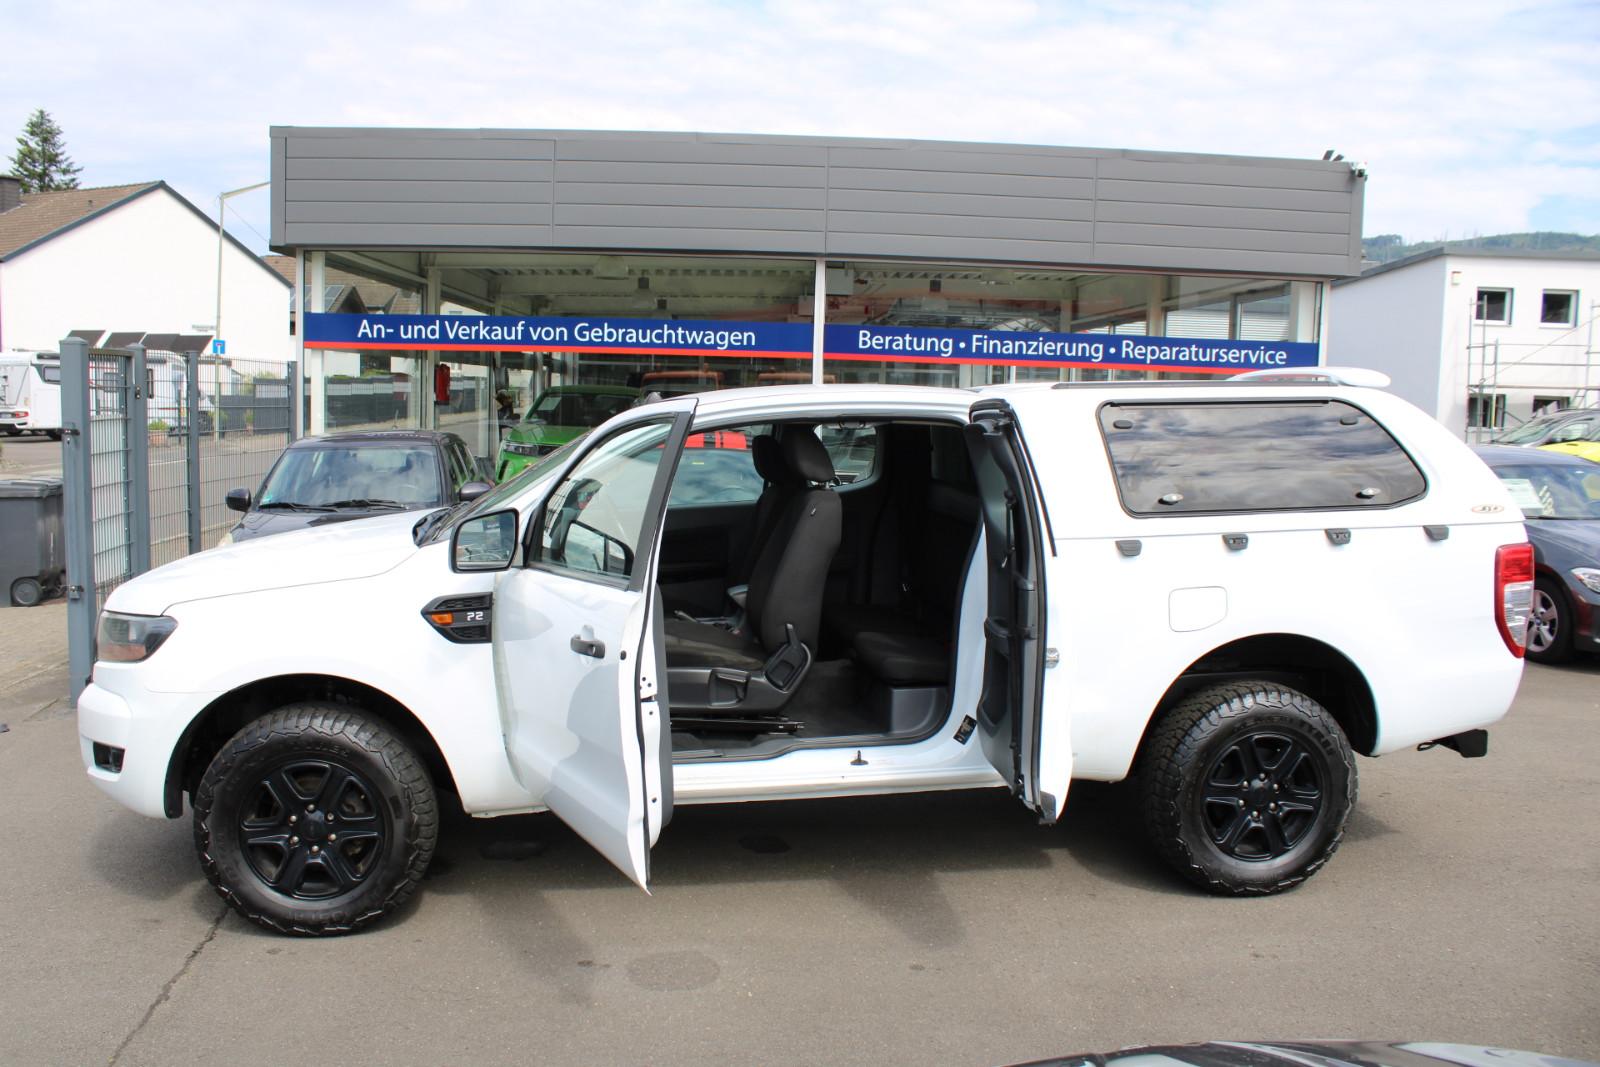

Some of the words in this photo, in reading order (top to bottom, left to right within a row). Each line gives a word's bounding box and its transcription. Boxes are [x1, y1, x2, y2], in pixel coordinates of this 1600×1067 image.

[358, 319, 394, 339] An-
[400, 319, 440, 340] und
[444, 320, 526, 341] Verkauf
[528, 326, 568, 342] von
[574, 322, 756, 351] Gebrauchtwagen
[858, 329, 954, 358] Beratung
[971, 334, 1104, 363] Finanzierung
[1121, 339, 1288, 365] Reparaturservice
